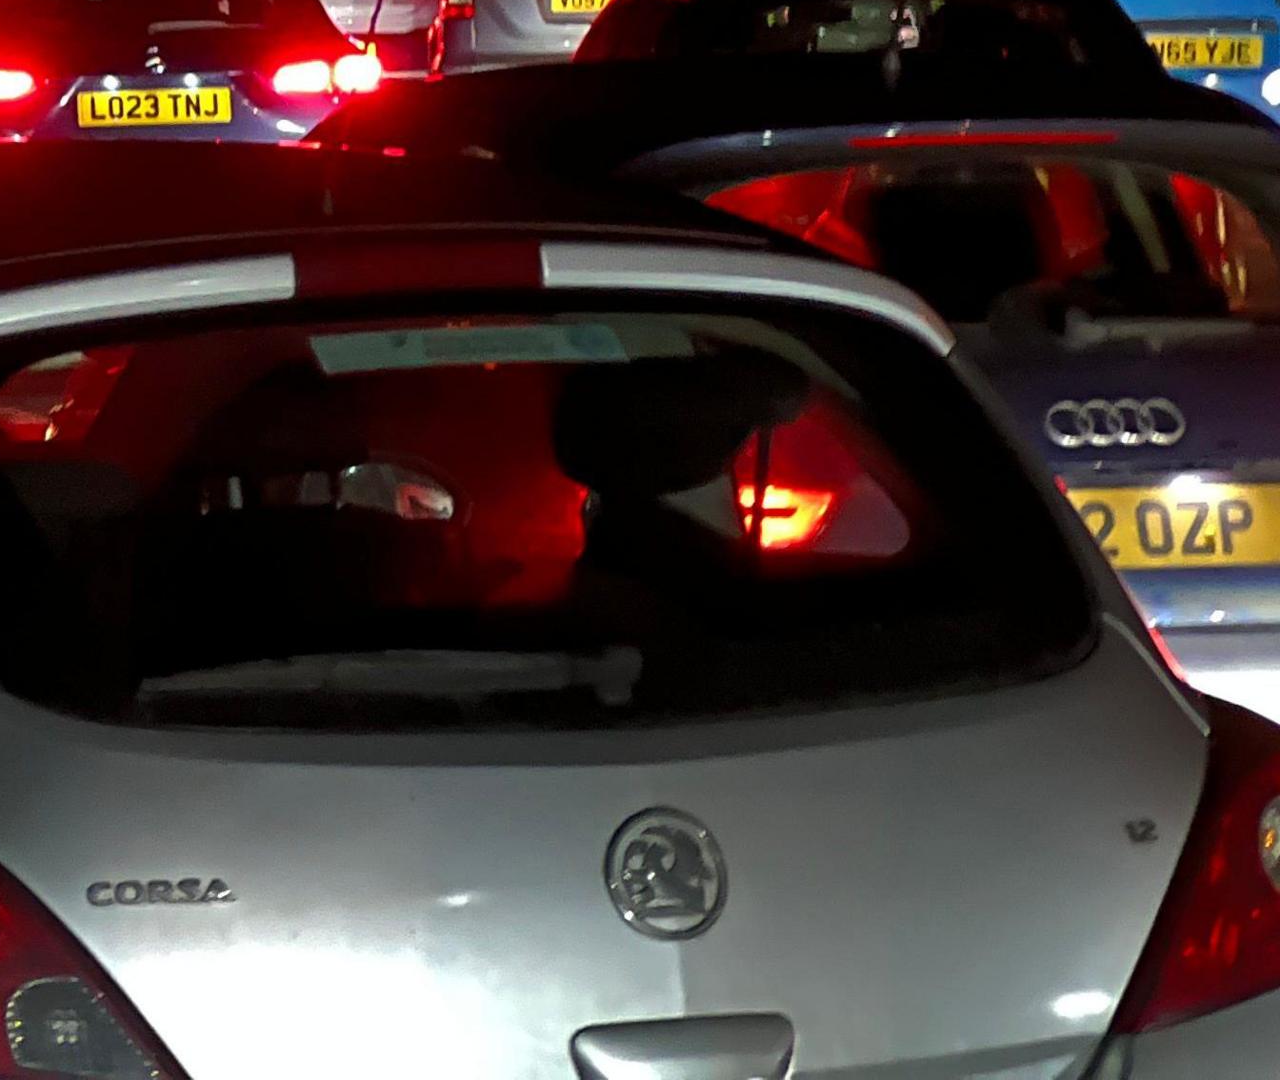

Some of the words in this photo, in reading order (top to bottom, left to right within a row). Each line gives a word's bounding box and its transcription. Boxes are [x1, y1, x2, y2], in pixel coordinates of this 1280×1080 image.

[90, 95, 160, 120] LO23
[169, 94, 219, 117] TNJ
[1136, 498, 1253, 557] OZP
[86, 878, 237, 906] CORSA
